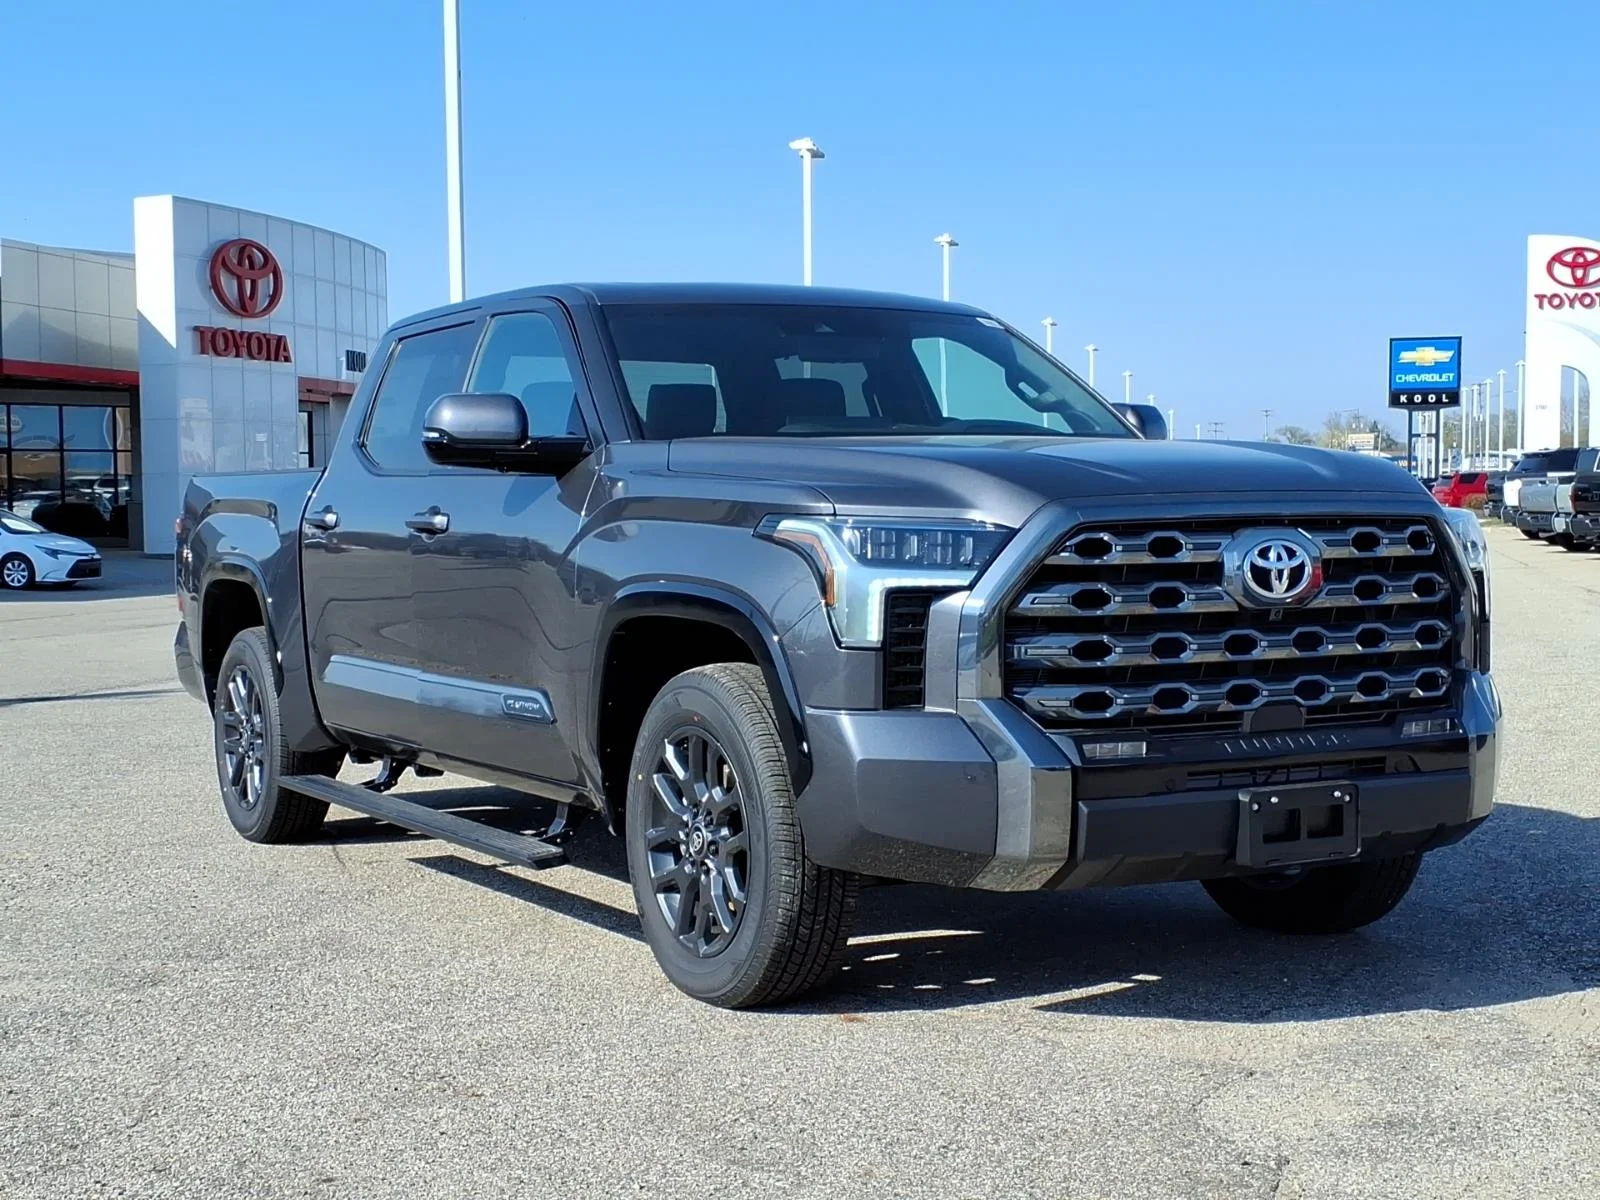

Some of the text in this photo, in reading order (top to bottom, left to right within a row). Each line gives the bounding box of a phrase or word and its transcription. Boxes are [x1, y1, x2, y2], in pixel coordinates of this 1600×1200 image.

[192, 325, 292, 363] TOYOTA
[1395, 372, 1455, 383] CHEVROLET
[1400, 394, 1449, 403] KOOL
